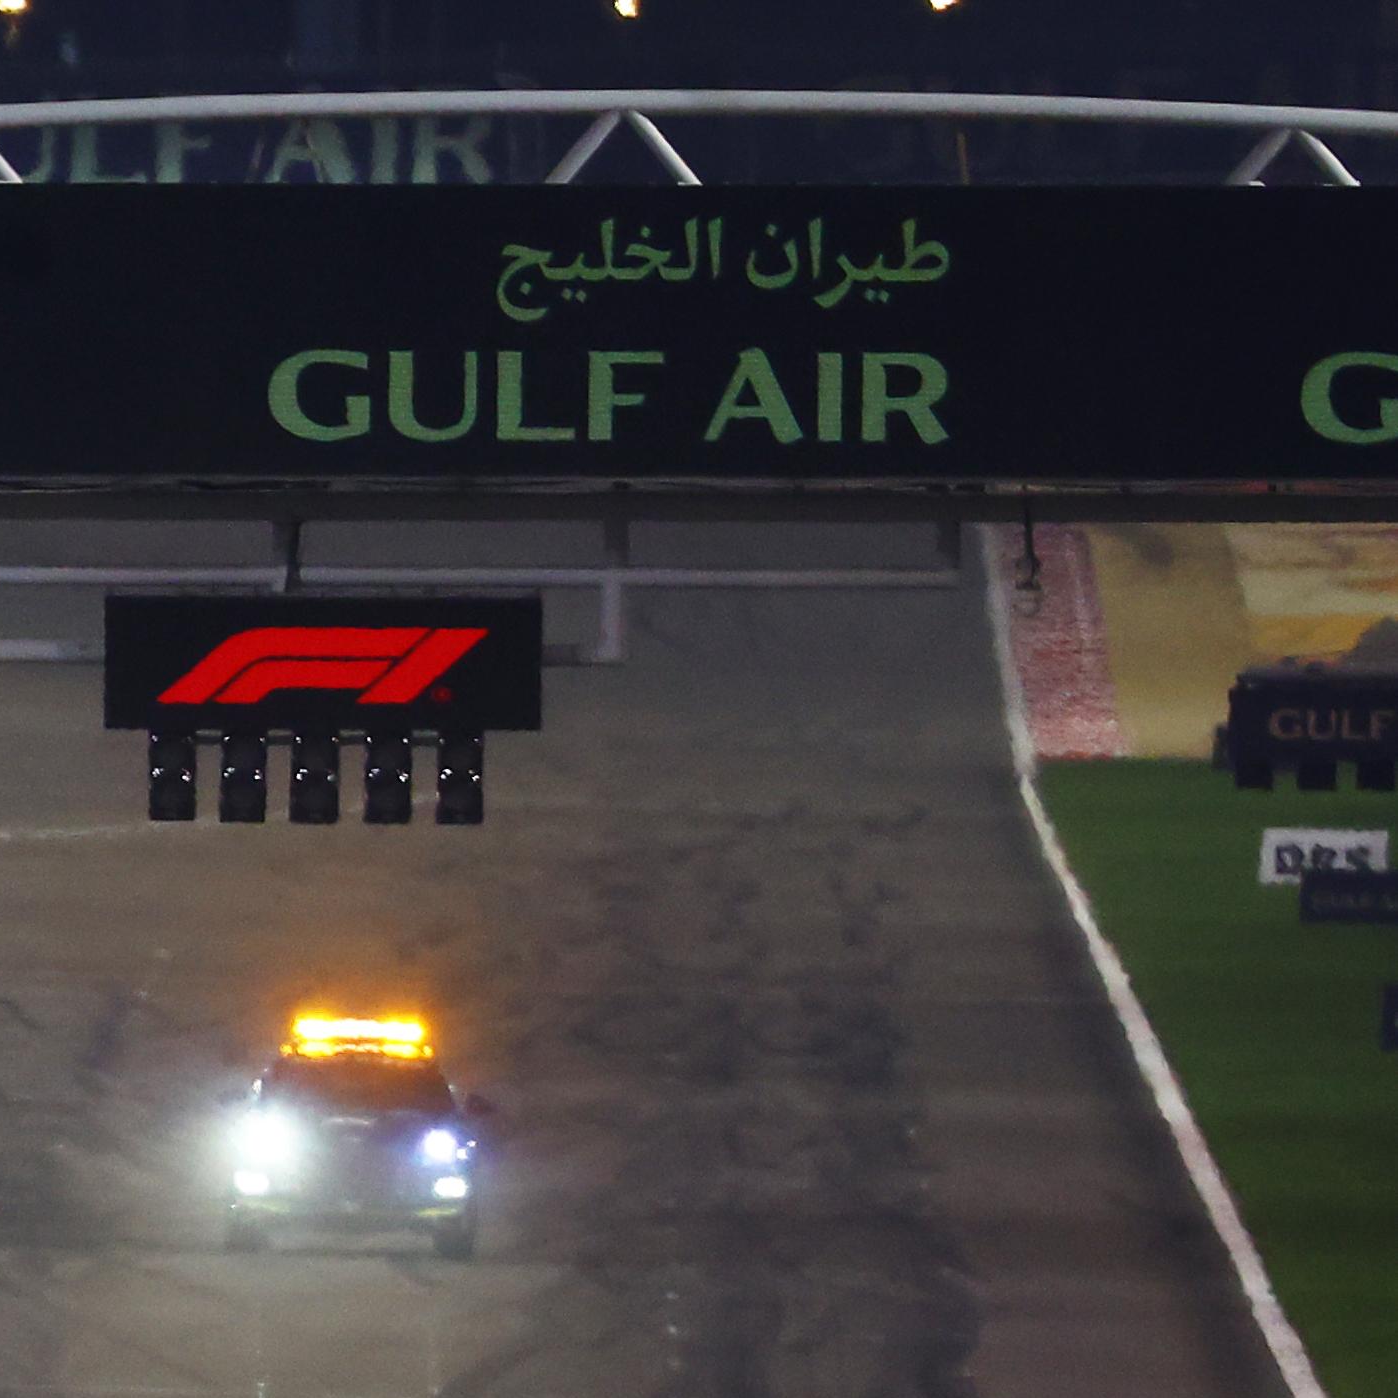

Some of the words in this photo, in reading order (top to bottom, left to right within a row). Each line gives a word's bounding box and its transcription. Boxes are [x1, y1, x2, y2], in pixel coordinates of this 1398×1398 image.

[496, 217, 724, 322] الخليج
[747, 219, 949, 308] طيران
[268, 350, 665, 442] GULF
[705, 348, 950, 444] AIR
